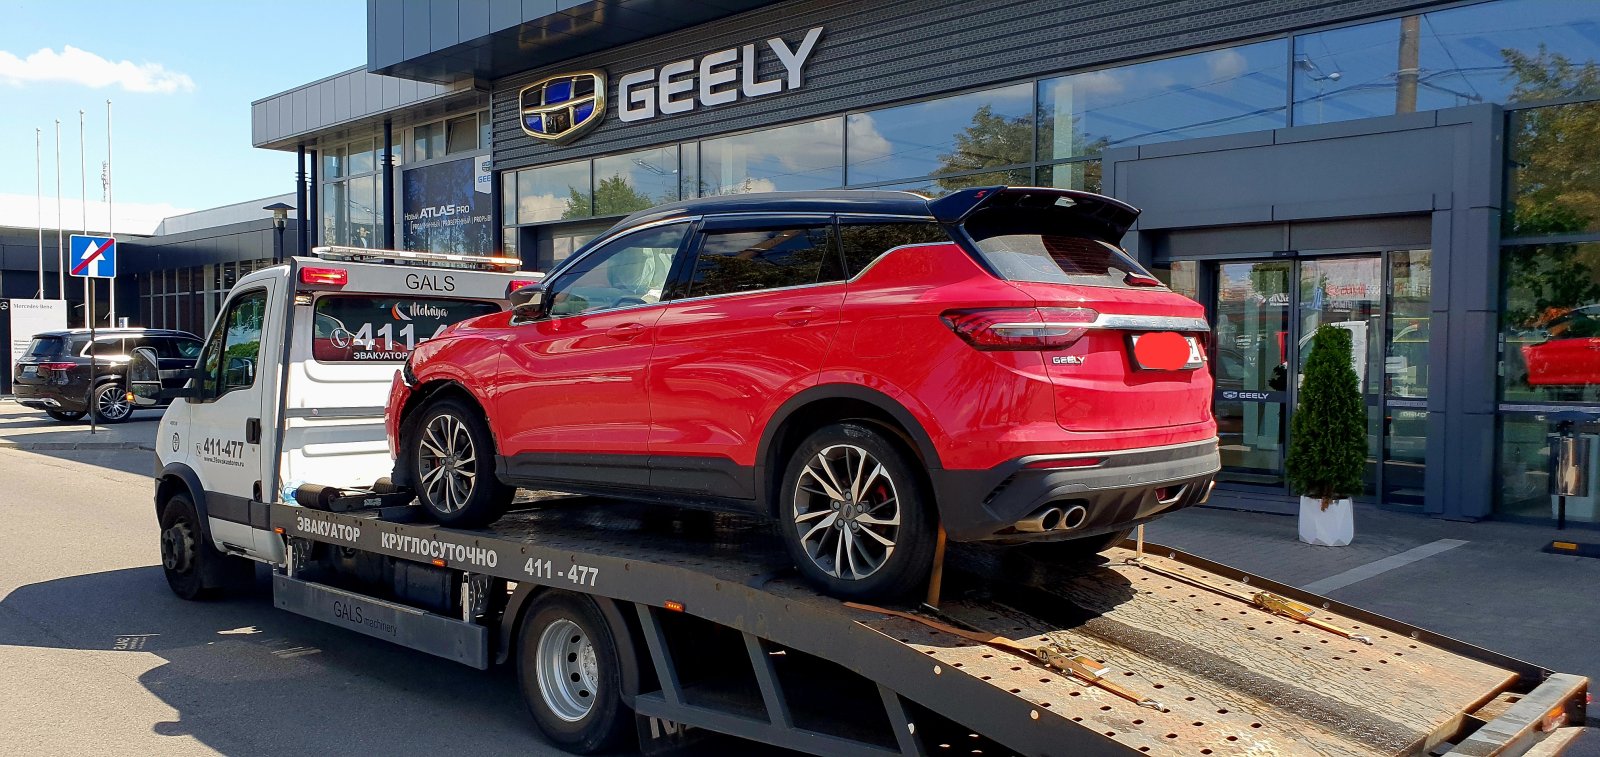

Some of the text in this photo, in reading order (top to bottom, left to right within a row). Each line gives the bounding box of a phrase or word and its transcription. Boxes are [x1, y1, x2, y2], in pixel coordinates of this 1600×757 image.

[618, 26, 824, 123] GEELY
[420, 204, 455, 219] ATLAS
[457, 205, 470, 214] PRO
[405, 273, 455, 292] GALS
[410, 301, 449, 320] Molniya
[353, 351, 408, 360] ЭВАКУАТОР
[1052, 355, 1085, 364] GEELY
[1238, 392, 1269, 400] GEELY
[203, 437, 244, 459] 411-477
[296, 516, 361, 543] ЭВАКУАТОР
[381, 531, 498, 568] КРУГЛОСУТОЧНО
[524, 557, 552, 579] 411
[567, 564, 599, 587] 477
[333, 600, 398, 637] GALS machinery
